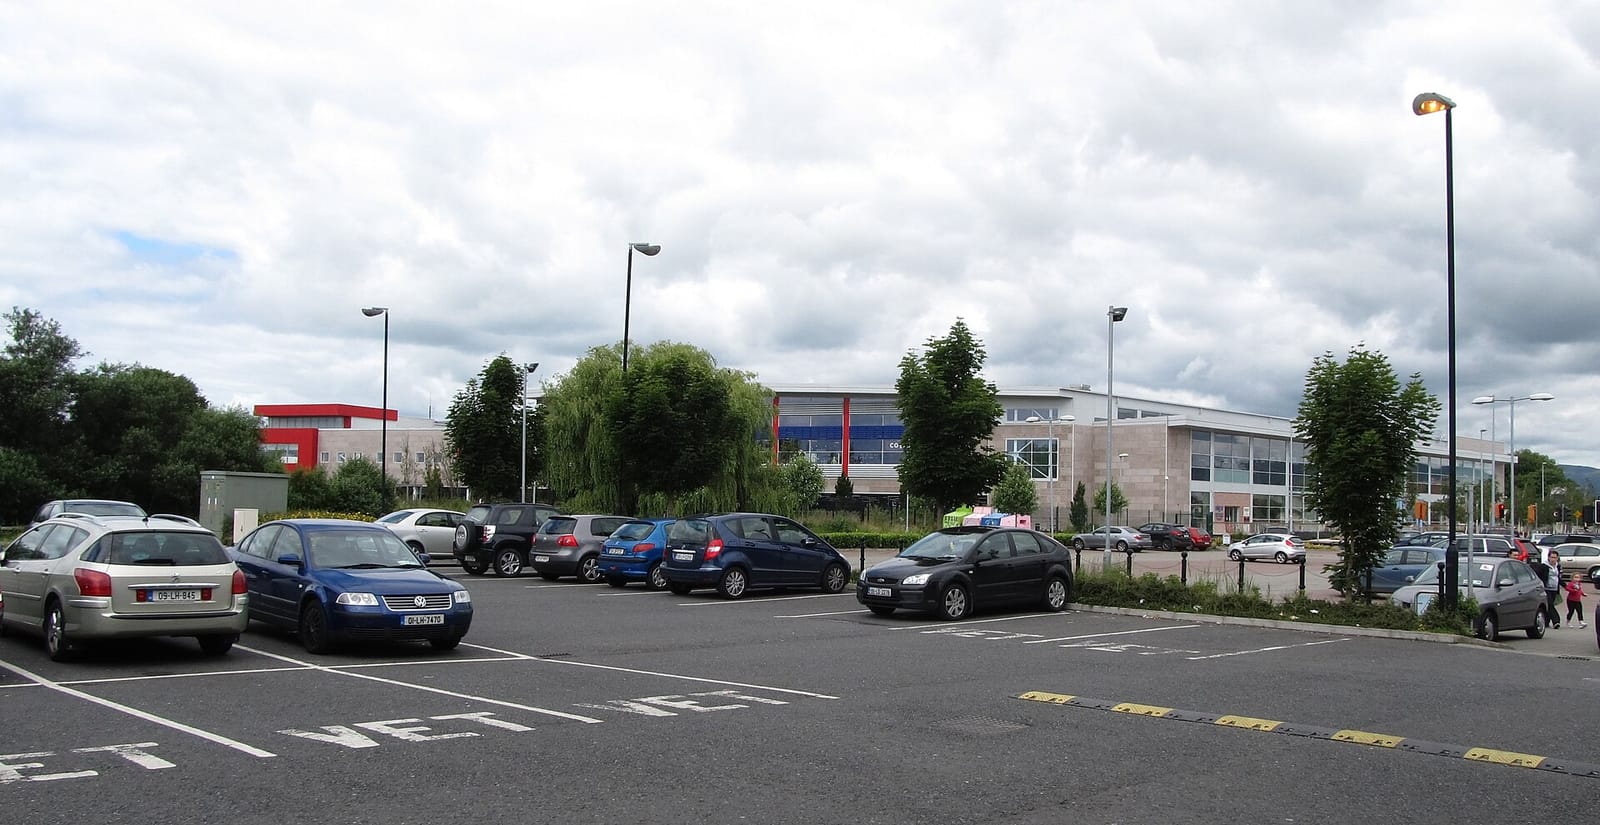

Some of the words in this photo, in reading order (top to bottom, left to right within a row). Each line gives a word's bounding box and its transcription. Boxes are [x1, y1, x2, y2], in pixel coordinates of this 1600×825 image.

[158, 591, 196, 600] 09-LH-845
[572, 690, 789, 717] VET
[275, 711, 537, 749] VET
